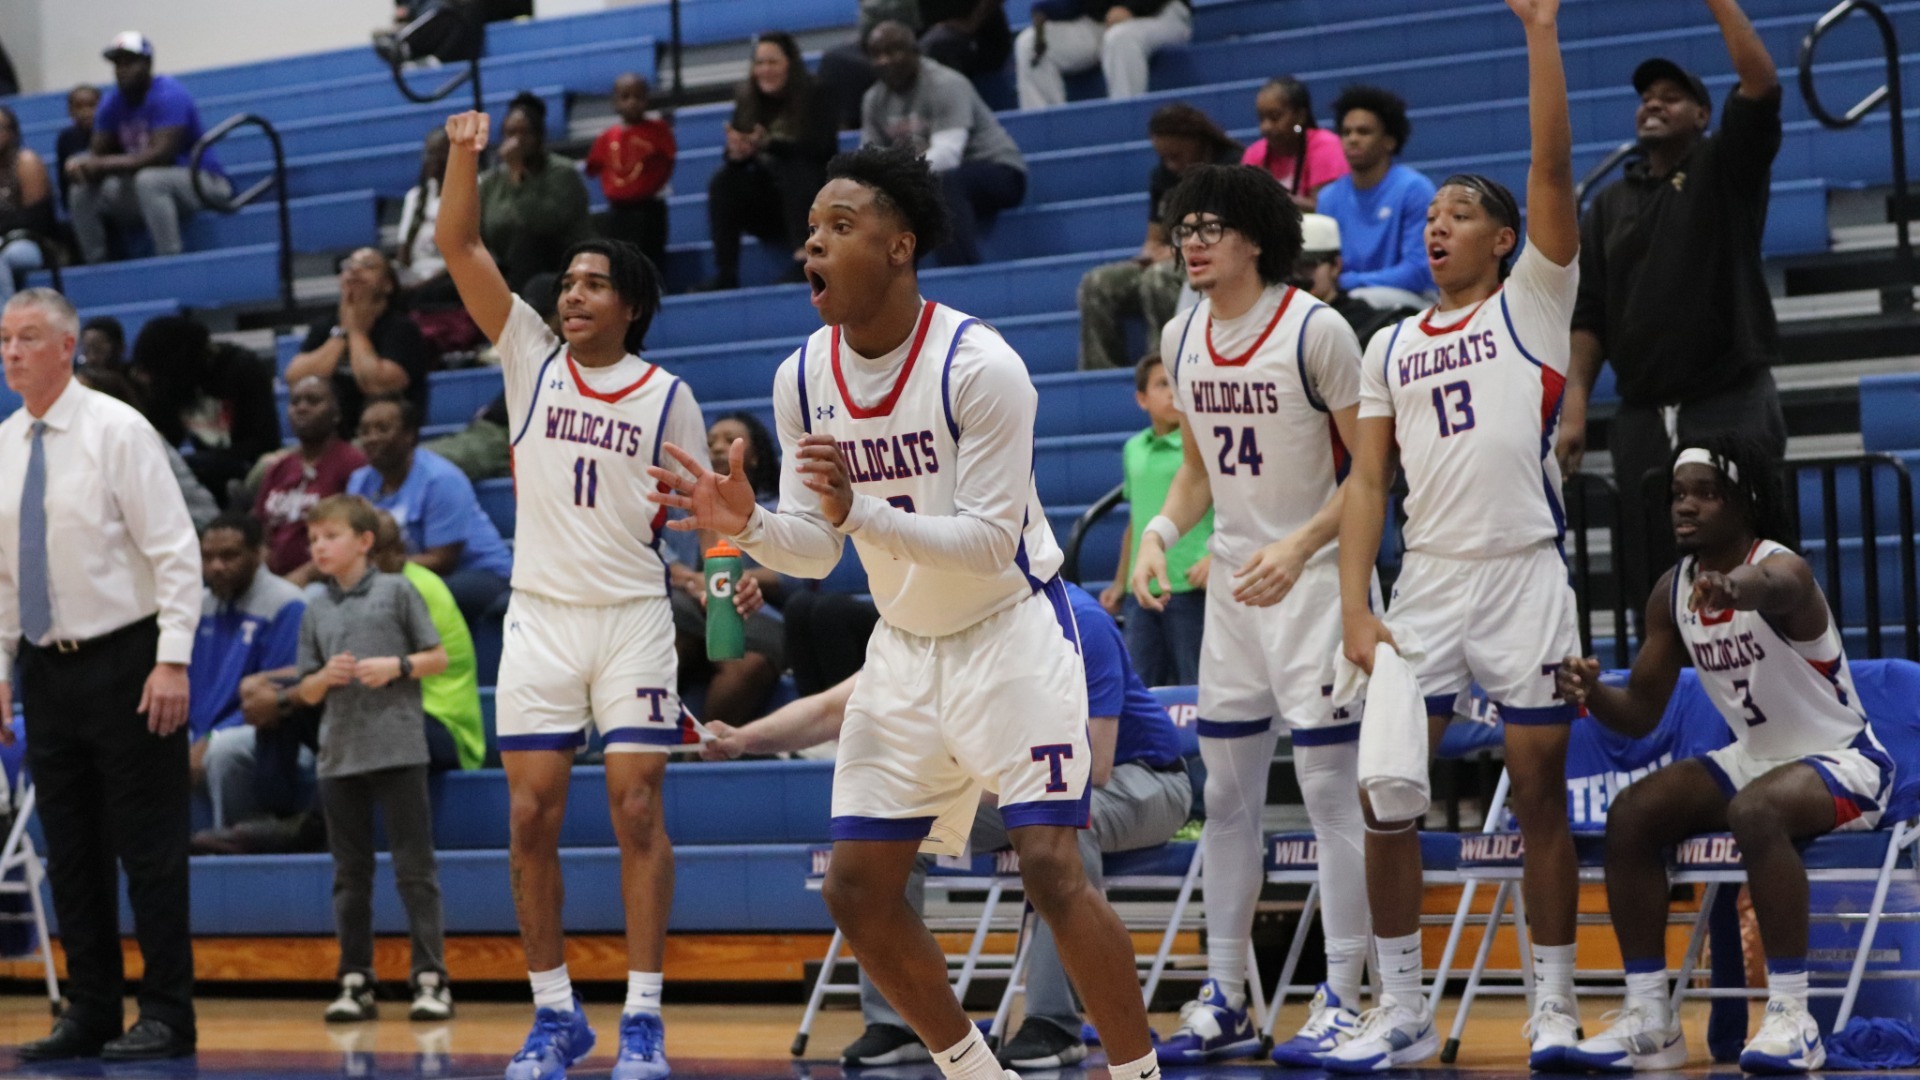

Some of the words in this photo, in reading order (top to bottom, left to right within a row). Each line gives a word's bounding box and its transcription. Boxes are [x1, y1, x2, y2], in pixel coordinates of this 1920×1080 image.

[1398, 329, 1498, 387] WILDCATS
[1191, 380, 1279, 414] WILDCATS
[1432, 379, 1476, 438] 13
[545, 405, 643, 457] WILDCATS
[1213, 426, 1264, 476] 24
[837, 430, 940, 483] ILDCATS
[574, 456, 597, 508] 11
[709, 570, 732, 598] G
[1692, 630, 1766, 673] WILDCATS
[636, 687, 668, 722] T
[1732, 678, 1768, 728] 3
[1030, 743, 1073, 793] T
[1676, 837, 1743, 865] WILDC
